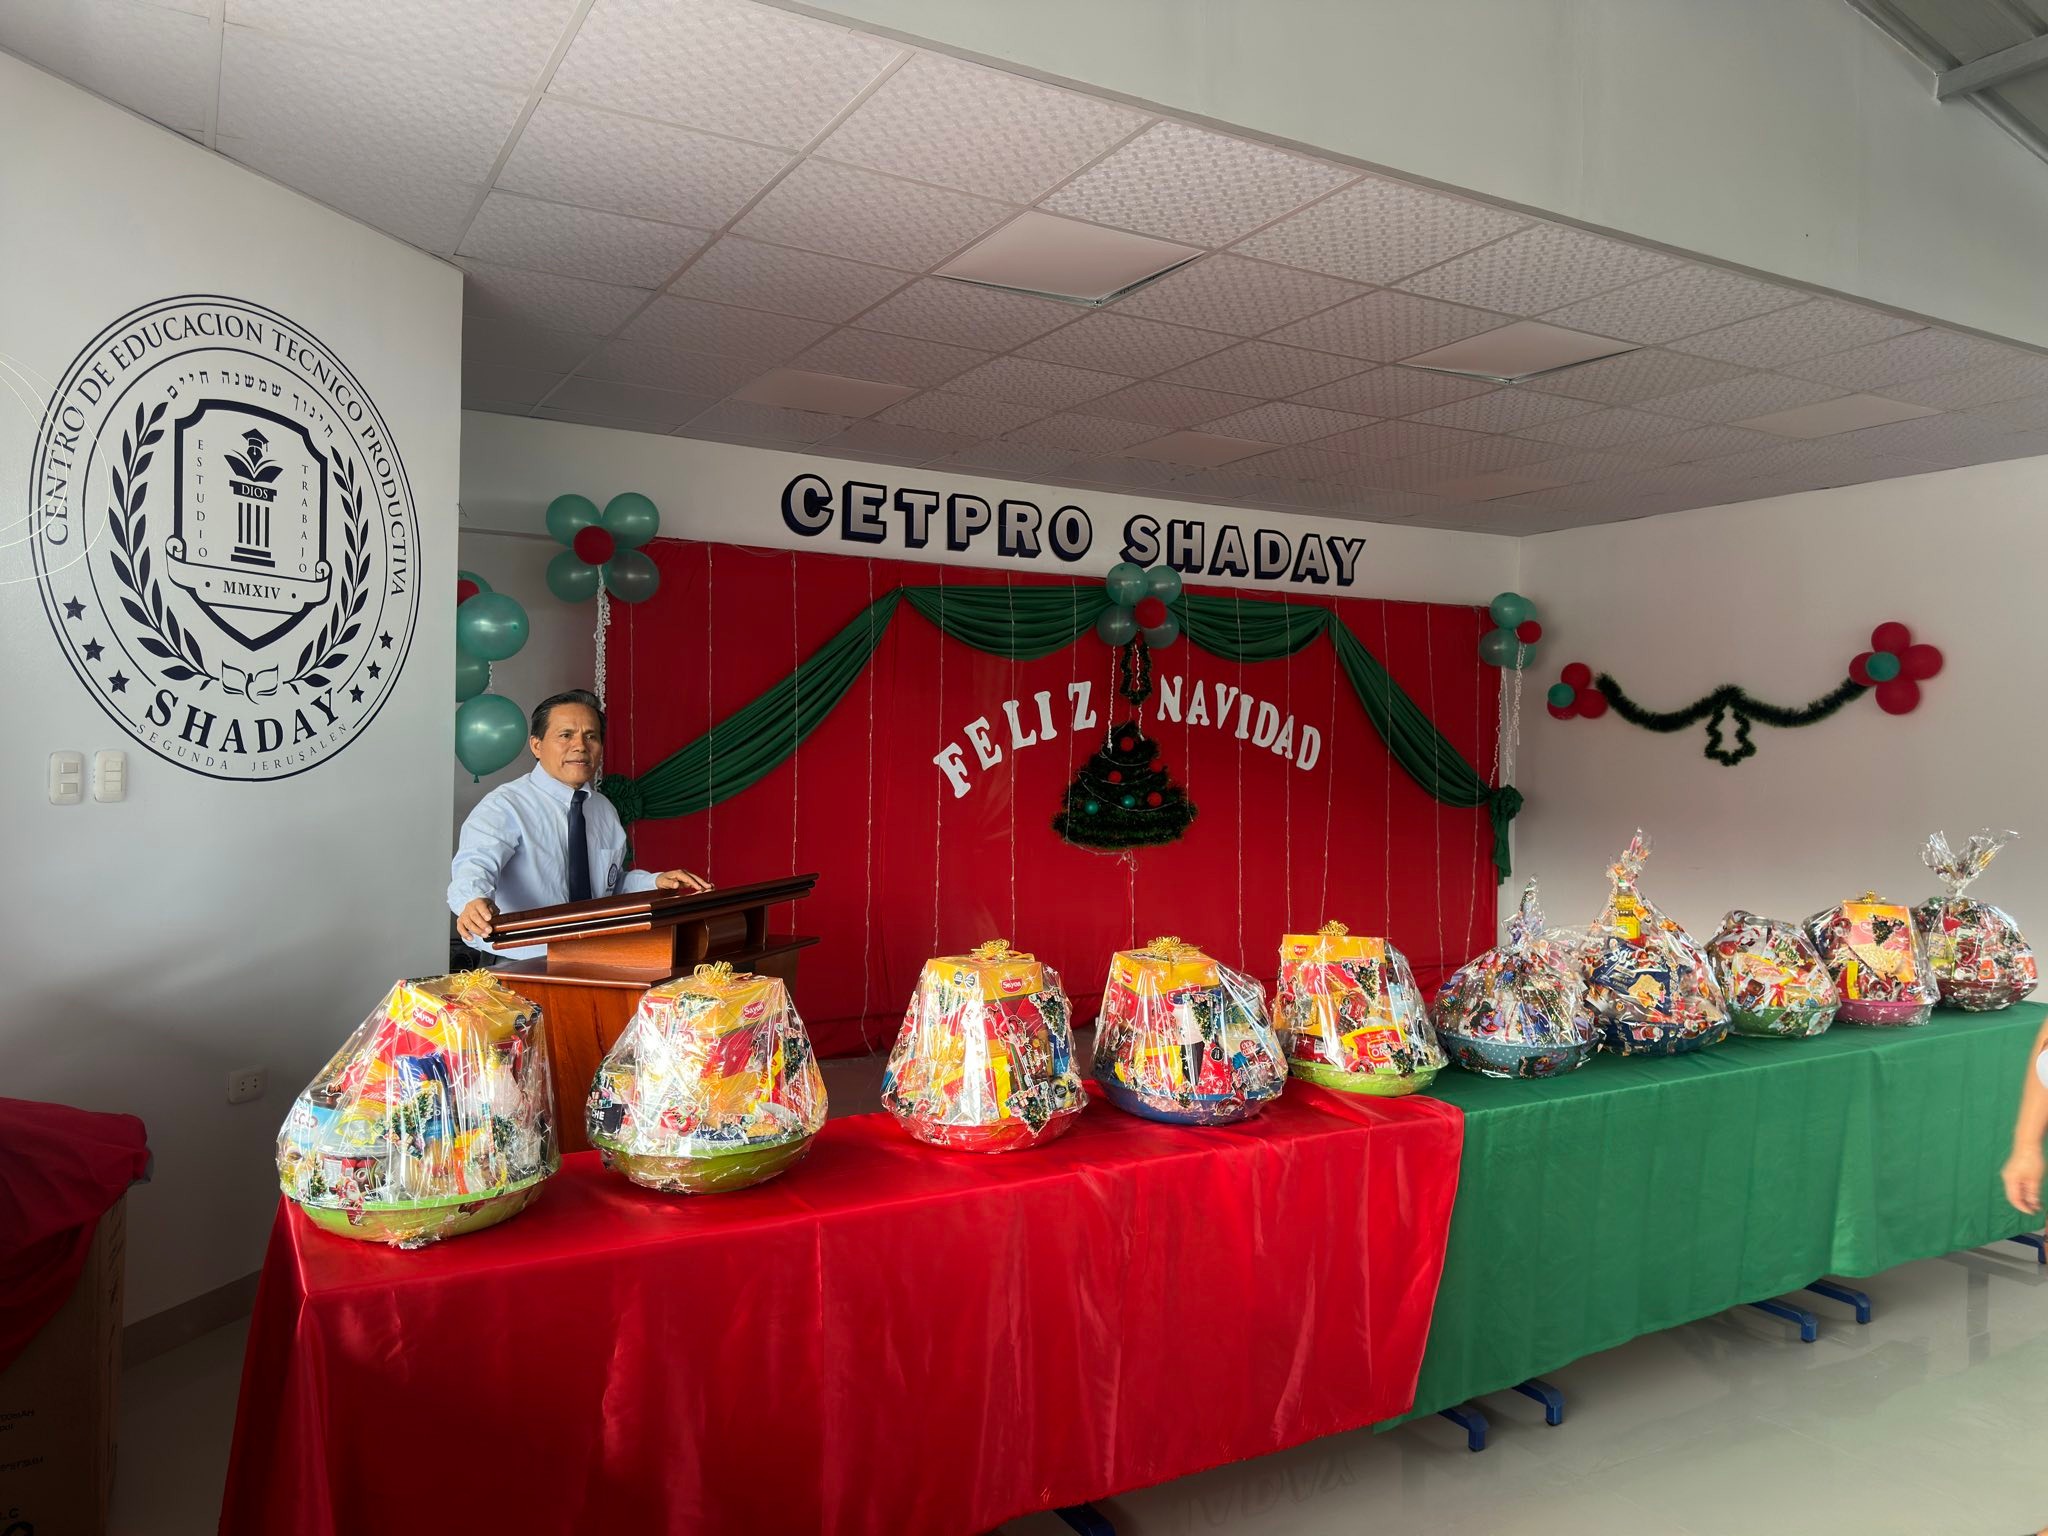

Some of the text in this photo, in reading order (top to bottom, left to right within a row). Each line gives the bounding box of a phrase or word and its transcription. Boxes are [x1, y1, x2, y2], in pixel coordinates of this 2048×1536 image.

[45, 313, 408, 597] CENTRO DE EDUCACION TECNICO PRODUCTIVA
[196, 439, 208, 558] ESTUDIO
[241, 484, 268, 499] DIOS
[298, 465, 309, 573] TRABAJO
[781, 474, 1366, 586] CETPRO SHADAY
[223, 581, 281, 599] MMXIV
[136, 723, 348, 771] SEGUNDA JERUSALEN
[145, 688, 339, 754] SHADAY
[933, 675, 1321, 798] FELIZ NAVIDAD
